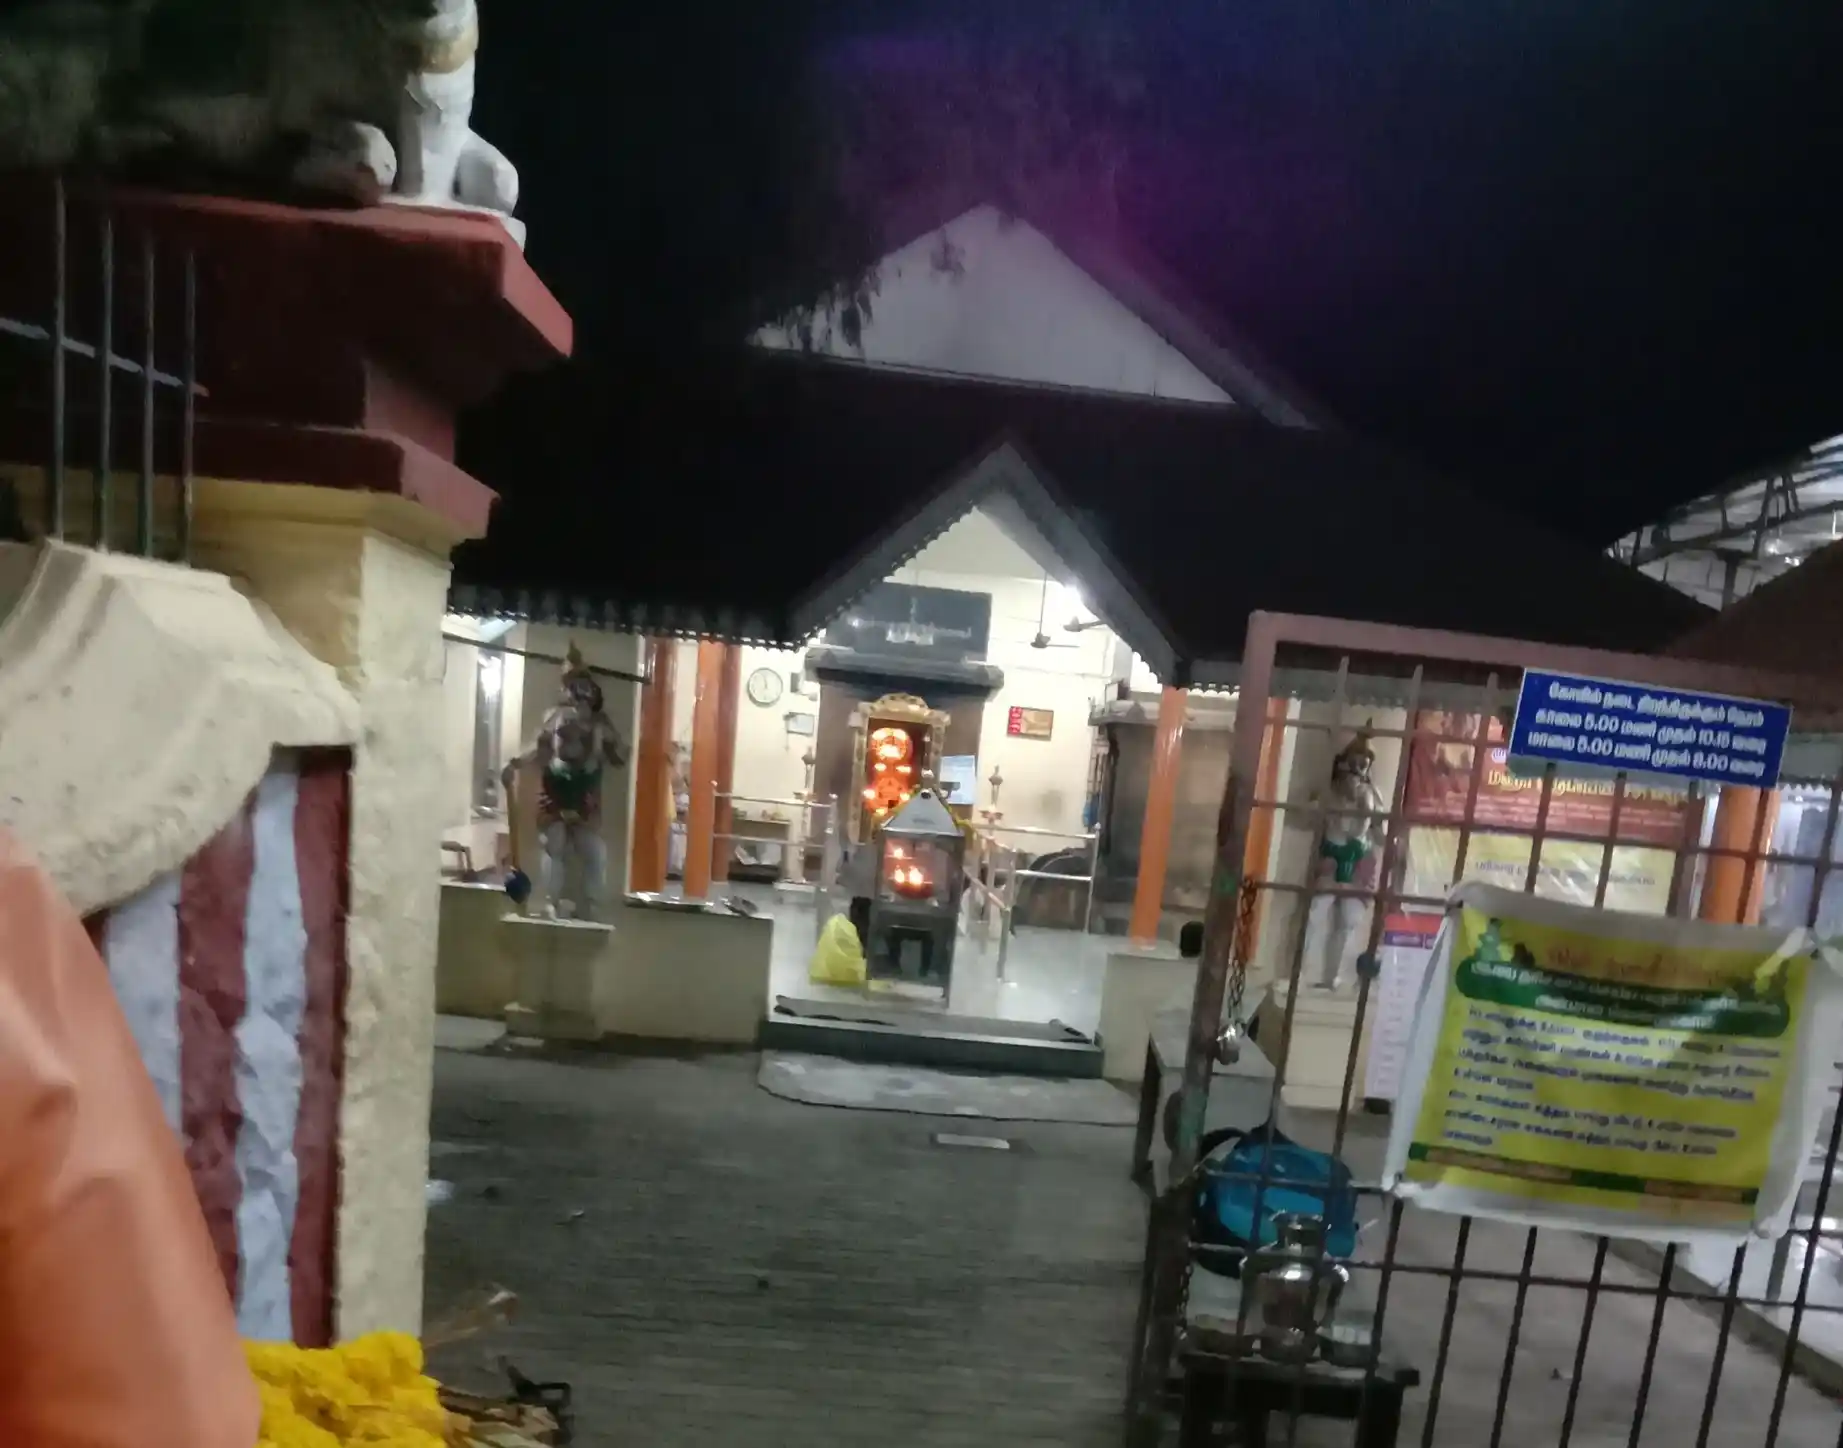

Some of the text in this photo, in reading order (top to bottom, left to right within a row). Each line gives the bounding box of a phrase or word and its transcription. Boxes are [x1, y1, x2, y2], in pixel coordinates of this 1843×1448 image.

[1536, 708, 1582, 729] காலை
[1657, 725, 1696, 745] முதல்
[1528, 731, 1575, 751] மாலை
[1651, 749, 1691, 768] முதல்
